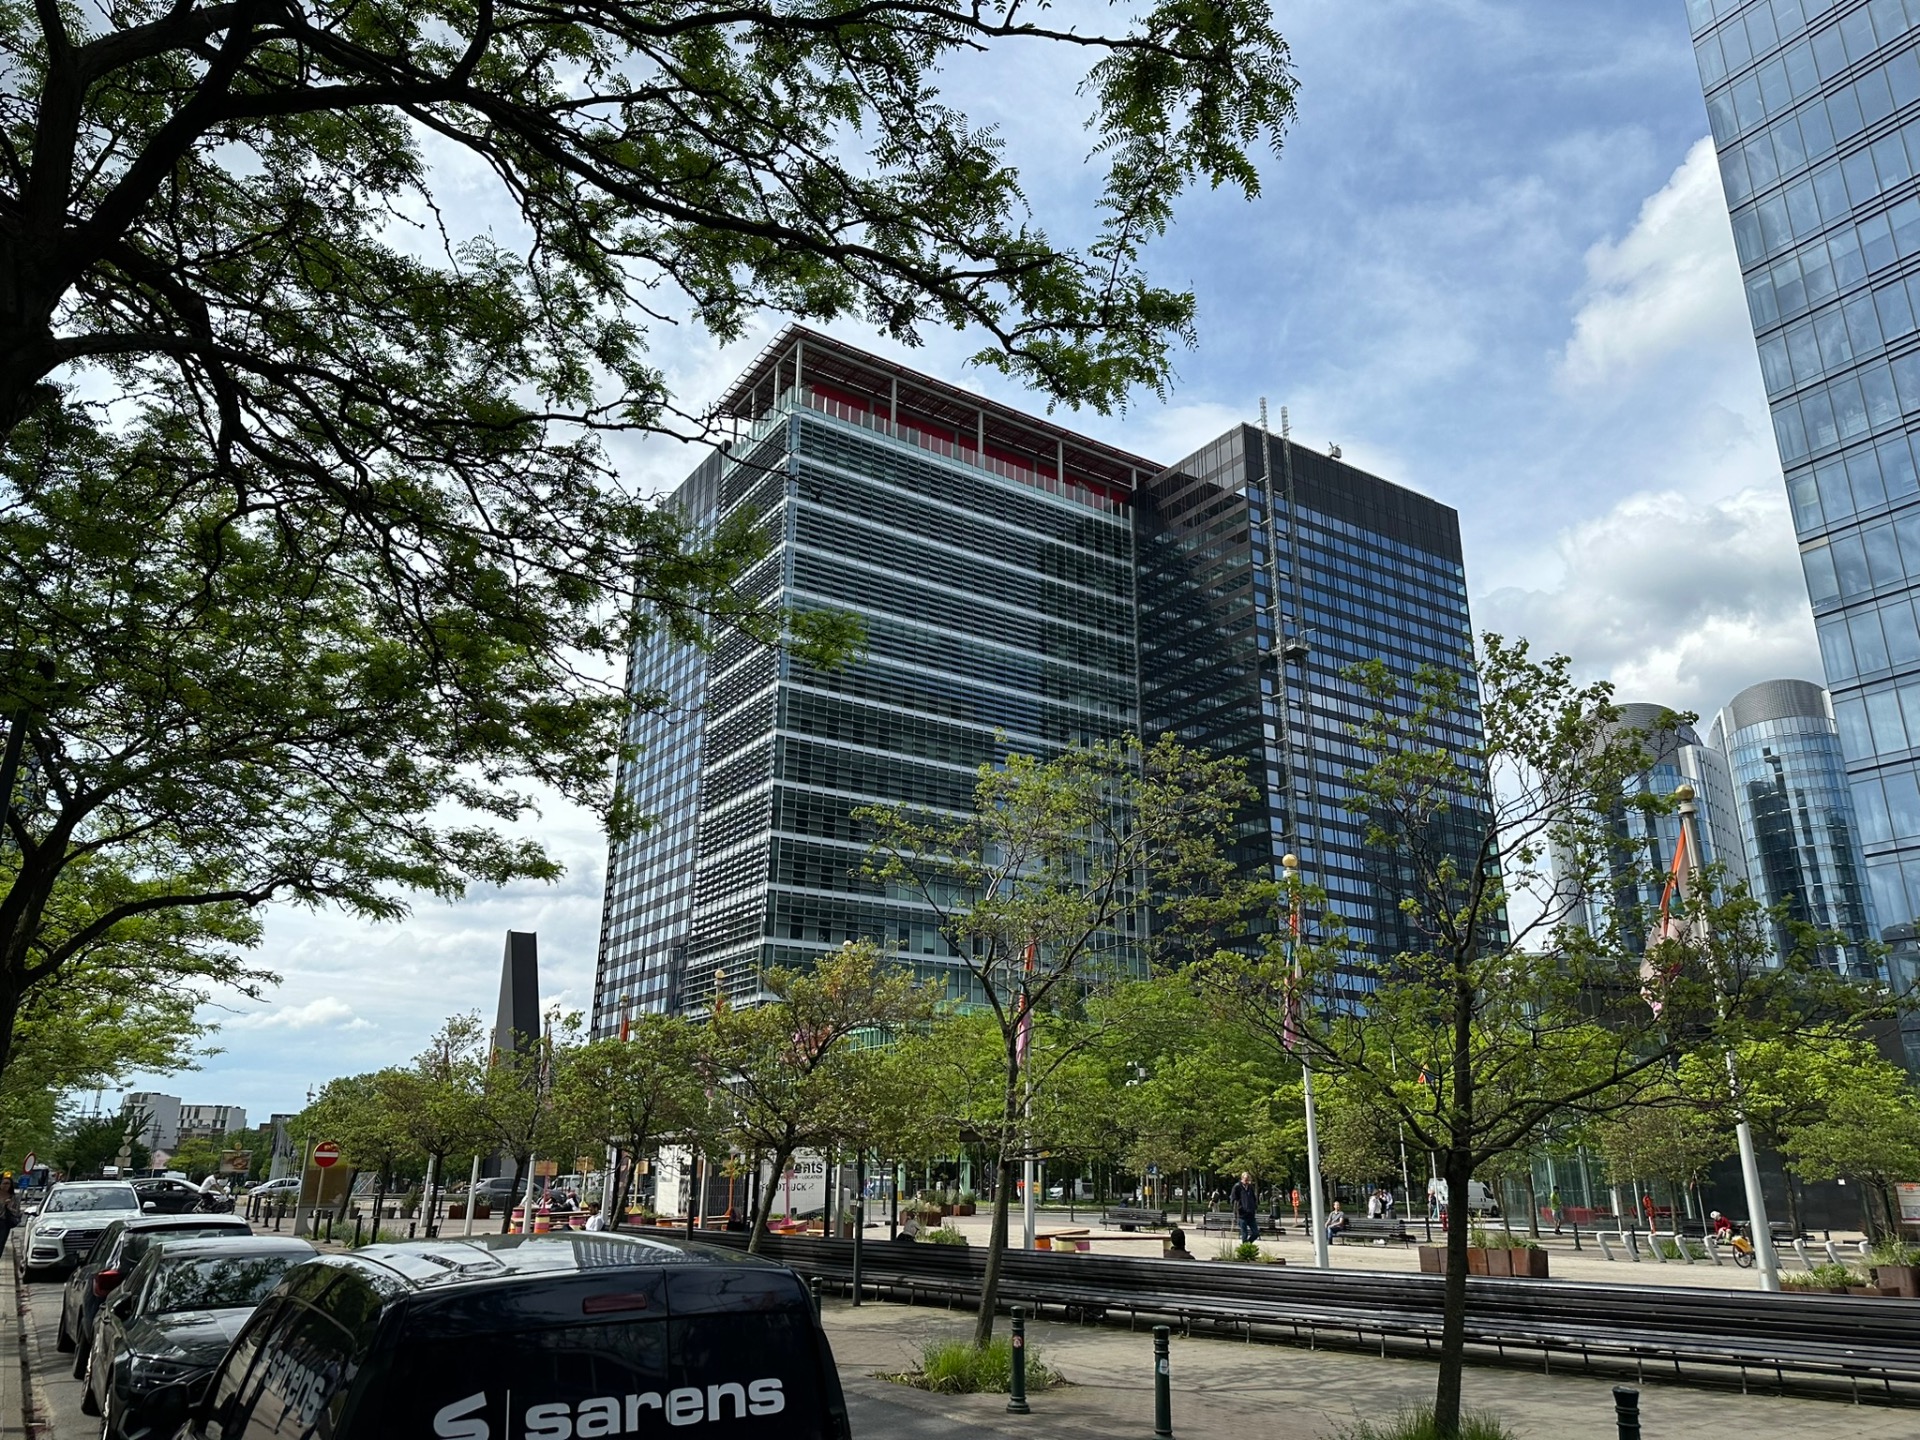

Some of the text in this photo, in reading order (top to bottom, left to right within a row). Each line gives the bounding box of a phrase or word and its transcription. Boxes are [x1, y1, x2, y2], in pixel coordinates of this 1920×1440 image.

[794, 1161, 823, 1174] ents
[264, 1349, 326, 1424] sarens
[524, 1378, 785, 1440] sarens
